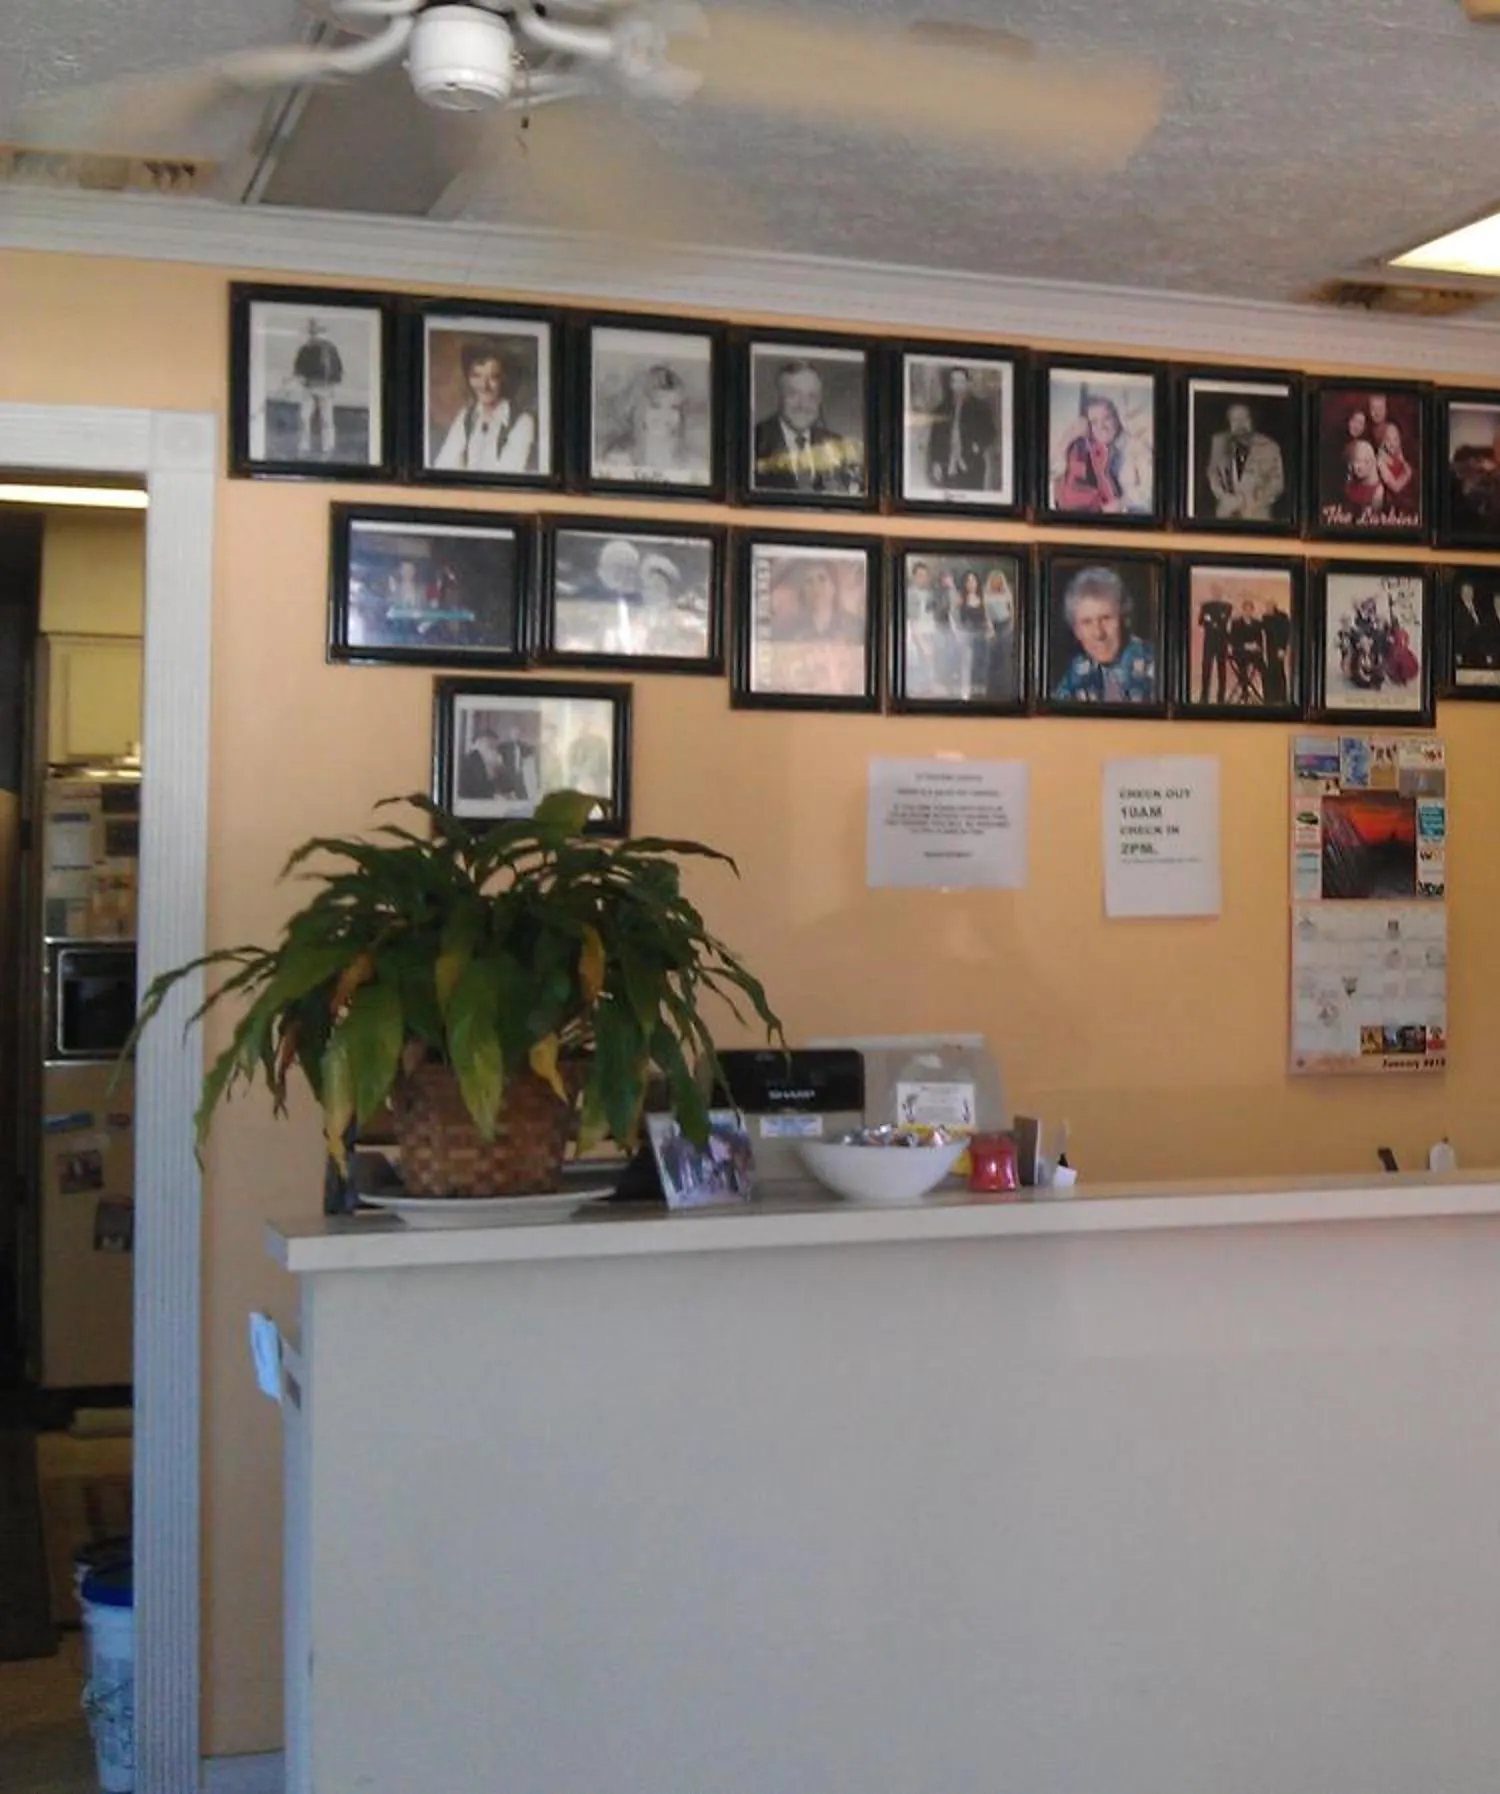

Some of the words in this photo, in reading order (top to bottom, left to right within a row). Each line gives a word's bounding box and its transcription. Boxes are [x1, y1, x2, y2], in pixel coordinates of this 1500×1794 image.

[1323, 504, 1352, 525] The
[1120, 789, 1161, 799] CHECK
[1166, 787, 1190, 799] OUT
[1122, 807, 1162, 819] 10AM
[1120, 826, 1162, 834] CHECK
